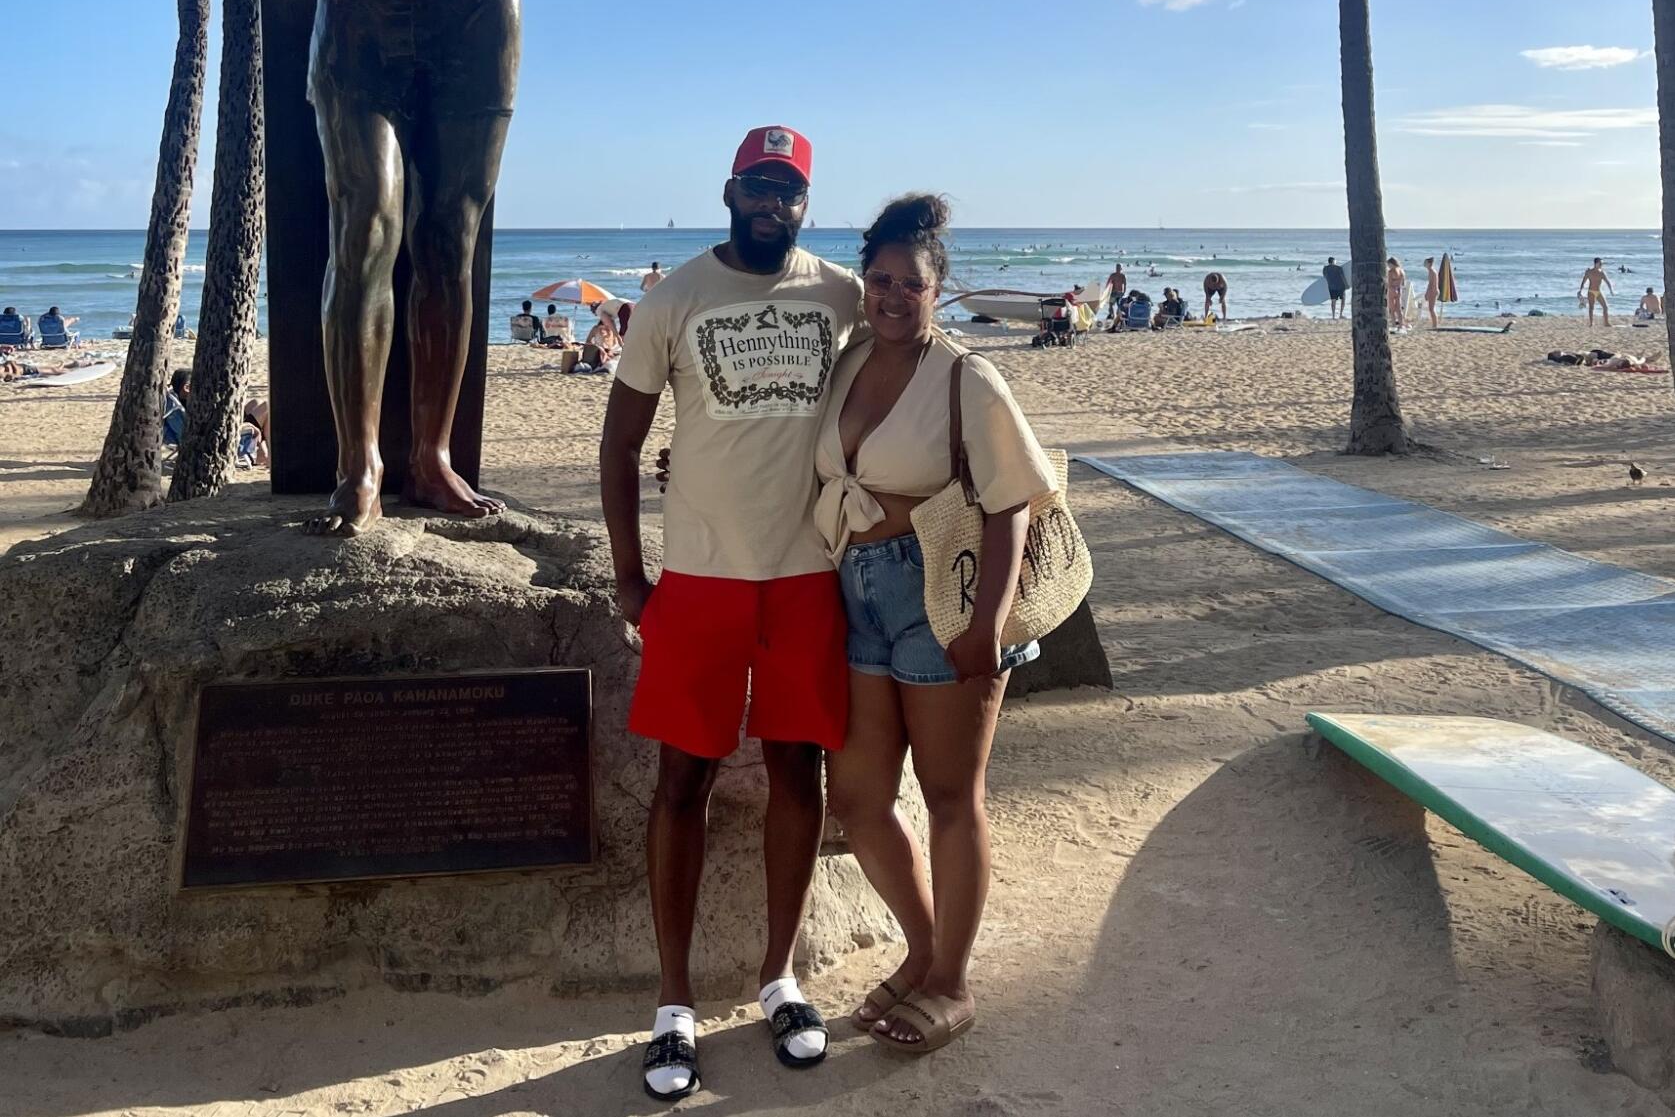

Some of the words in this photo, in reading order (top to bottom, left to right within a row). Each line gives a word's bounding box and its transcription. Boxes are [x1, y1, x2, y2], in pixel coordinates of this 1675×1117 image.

[719, 330, 821, 357] Hennything
[733, 358, 745, 371] IS
[749, 355, 812, 368] POSSIBLE
[289, 692, 336, 706] DUKE
[343, 691, 384, 704] PAOA
[393, 685, 505, 702] KAHANAMOKU
